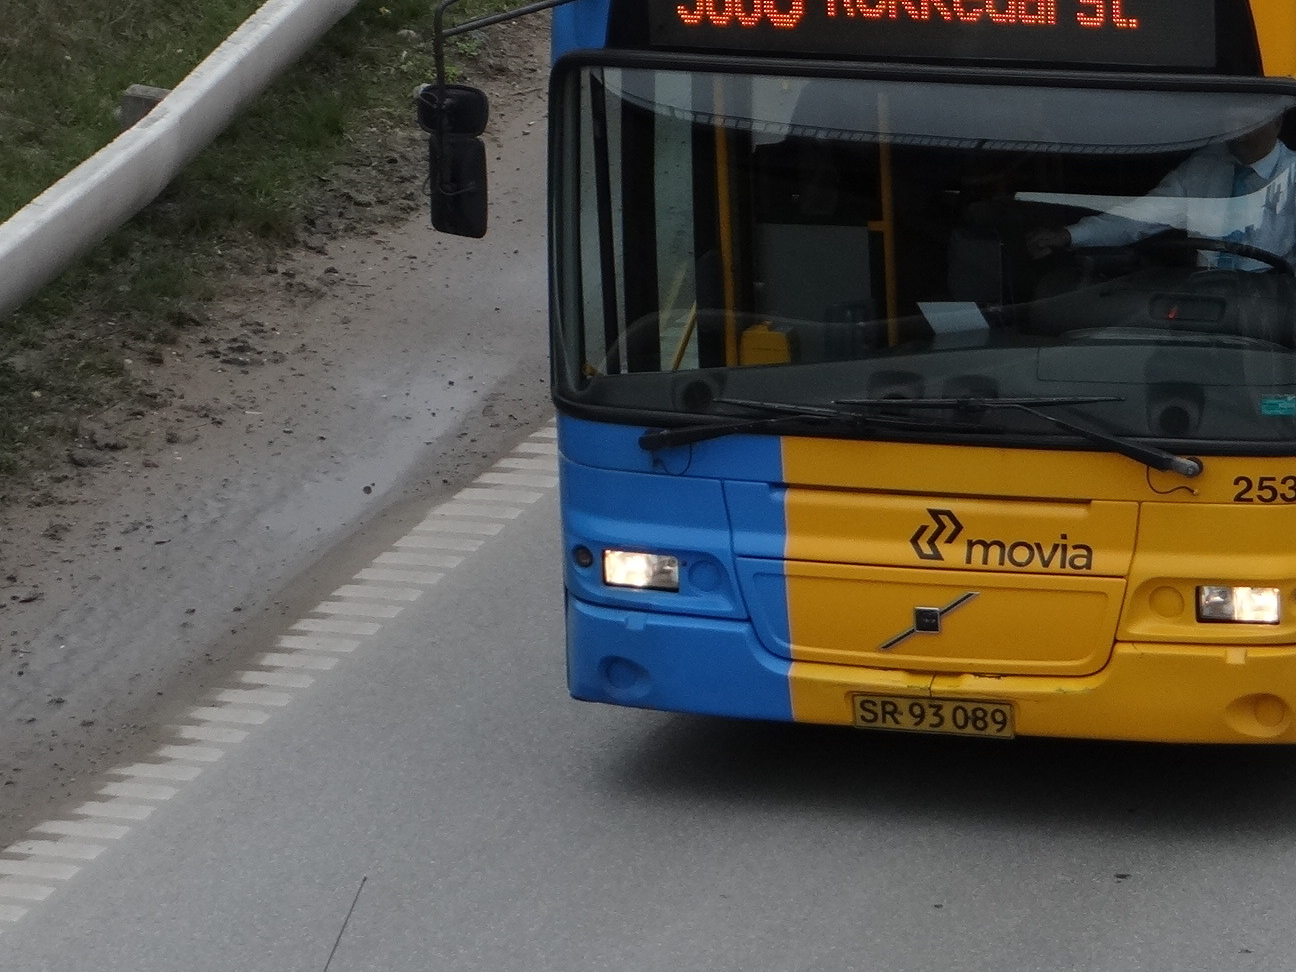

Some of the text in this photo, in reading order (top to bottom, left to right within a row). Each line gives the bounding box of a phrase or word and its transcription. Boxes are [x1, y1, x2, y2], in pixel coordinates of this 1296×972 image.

[965, 533, 1094, 571] movia
[859, 698, 1009, 733] SR 93 089
